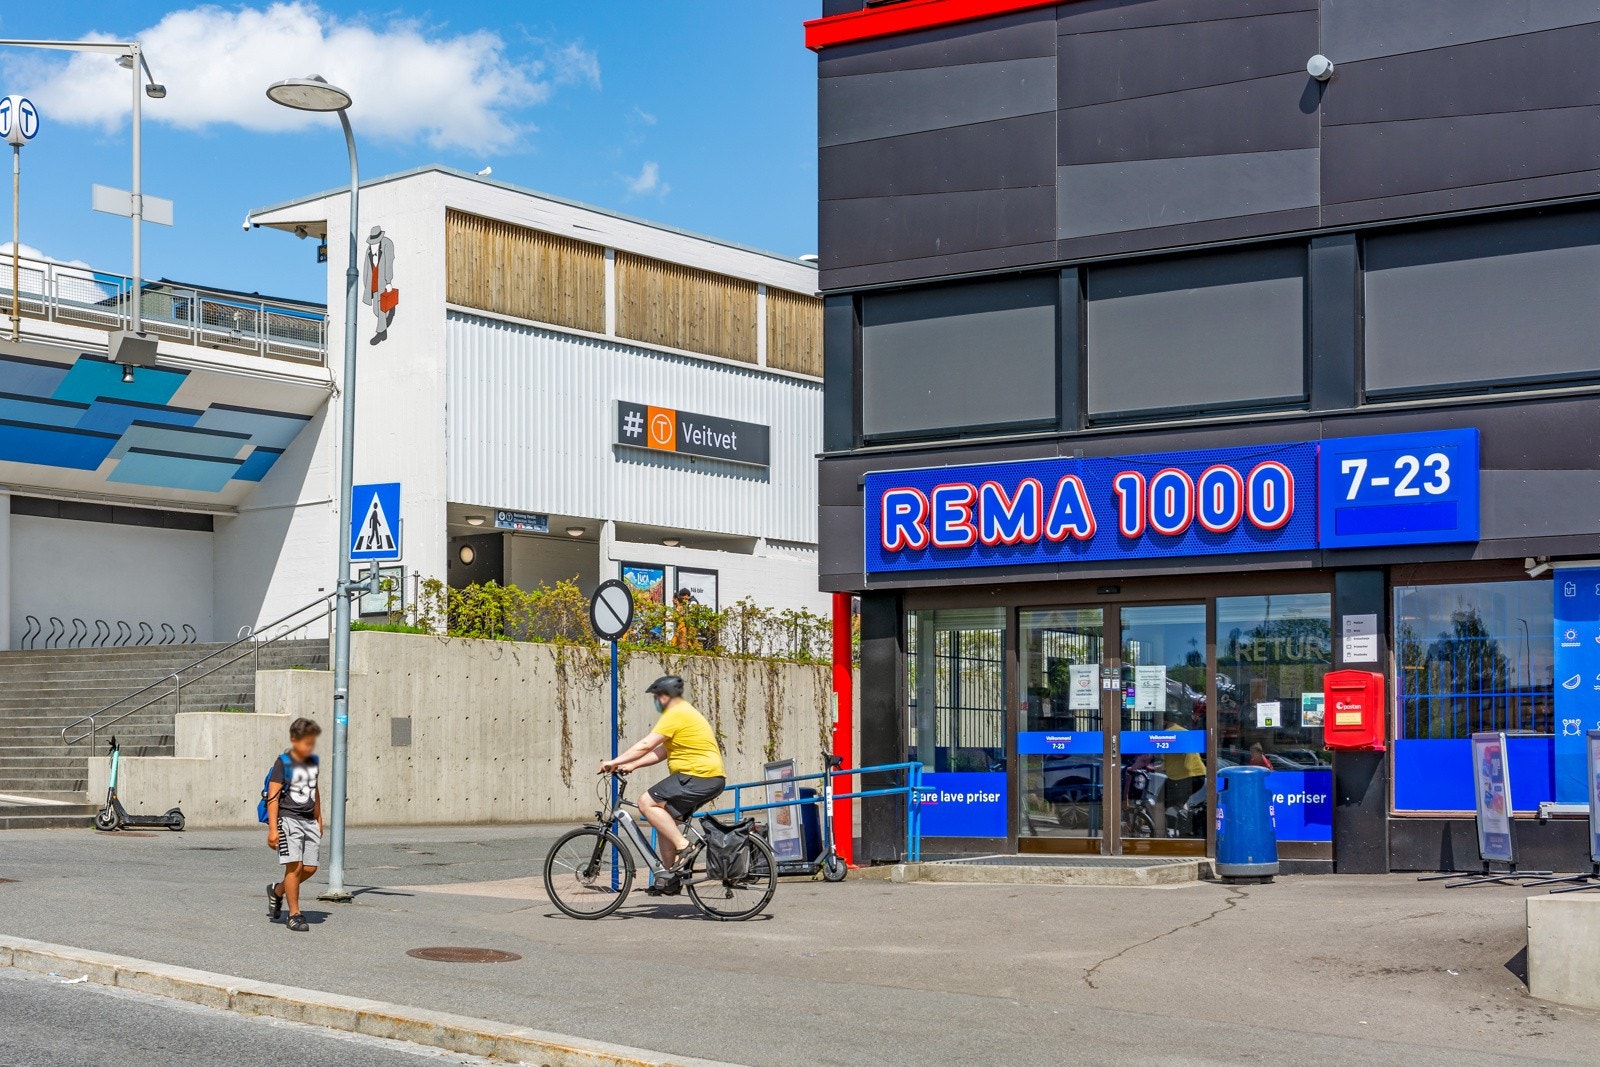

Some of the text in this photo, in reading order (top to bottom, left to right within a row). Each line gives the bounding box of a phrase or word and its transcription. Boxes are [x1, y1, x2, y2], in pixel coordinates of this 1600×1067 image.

[21, 107, 33, 132] T
[657, 420, 667, 440] T
[682, 422, 737, 450] Veitvet
[1341, 453, 1451, 500] 7-23
[881, 460, 1295, 552] REMA 1000
[1234, 636, 1324, 662] RETUR
[940, 790, 964, 802] lave
[966, 790, 1000, 804] priser
[1287, 791, 1326, 806] priser
